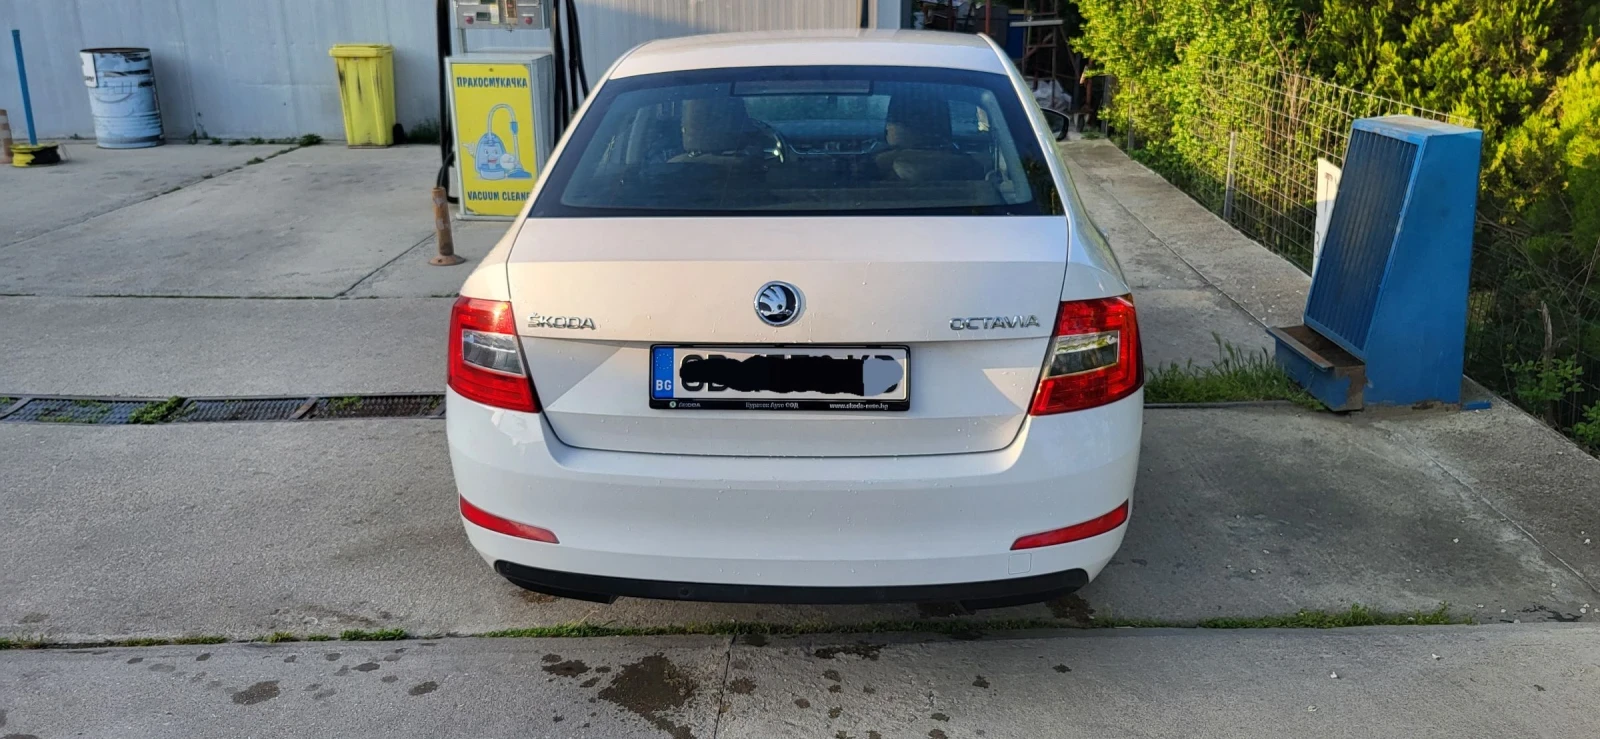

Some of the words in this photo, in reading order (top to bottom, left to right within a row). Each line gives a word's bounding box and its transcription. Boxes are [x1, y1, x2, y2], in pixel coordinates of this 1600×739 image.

[456, 76, 527, 88] ПРАХОСМУКАЧКА
[467, 190, 500, 201] VACUUM
[502, 191, 531, 201] CLEANE
[527, 312, 596, 330] ŠKODA
[949, 314, 1040, 330] OCTAVIA
[656, 379, 672, 391] BG
